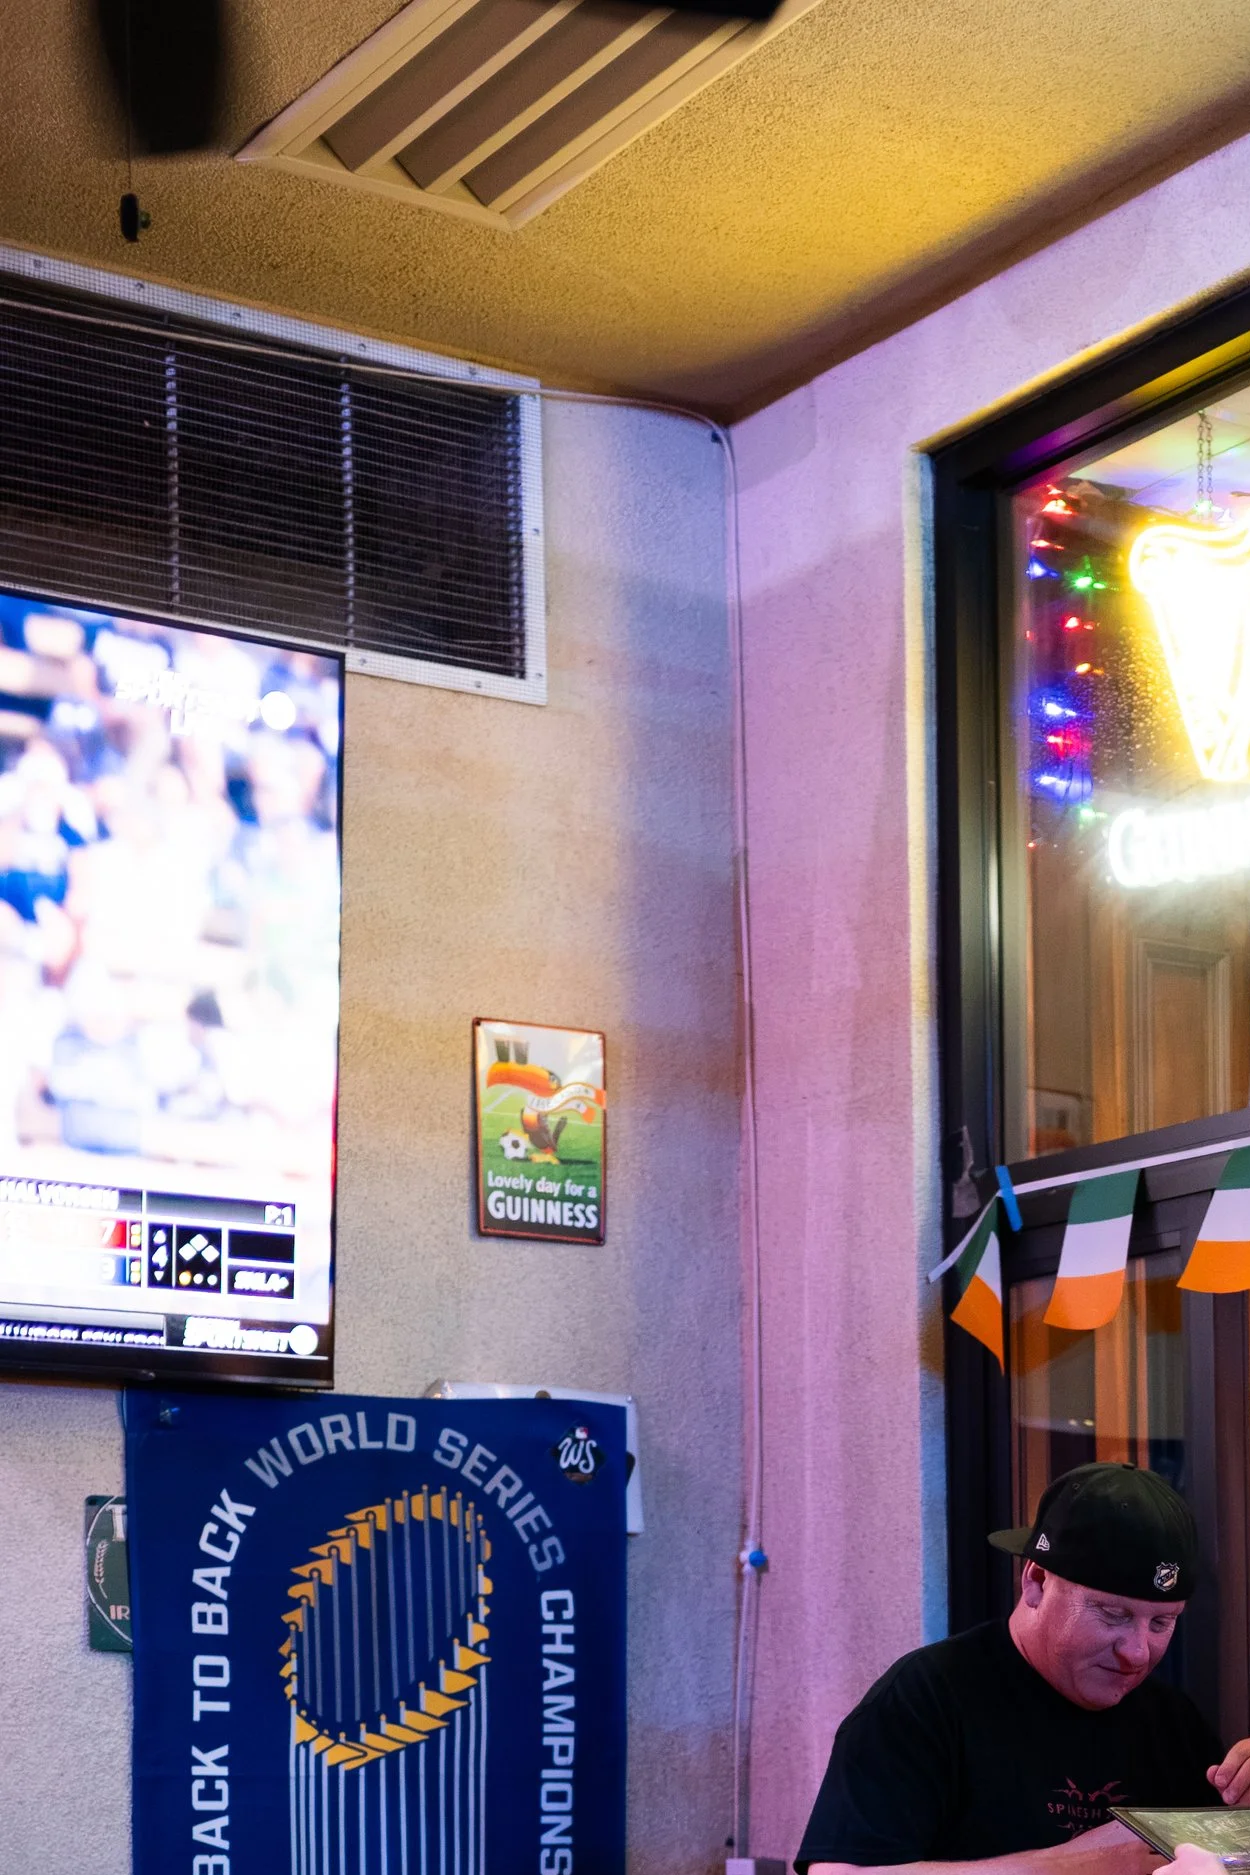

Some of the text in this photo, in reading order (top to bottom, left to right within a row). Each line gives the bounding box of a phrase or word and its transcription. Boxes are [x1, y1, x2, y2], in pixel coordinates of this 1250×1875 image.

[487, 1170, 597, 1198] Lovely day for a
[487, 1191, 598, 1229] GUINNESS
[243, 1411, 416, 1489] WORLD
[433, 1427, 565, 1572] SERIES
[191, 1488, 257, 1635] BACK
[192, 1654, 230, 1722] TO
